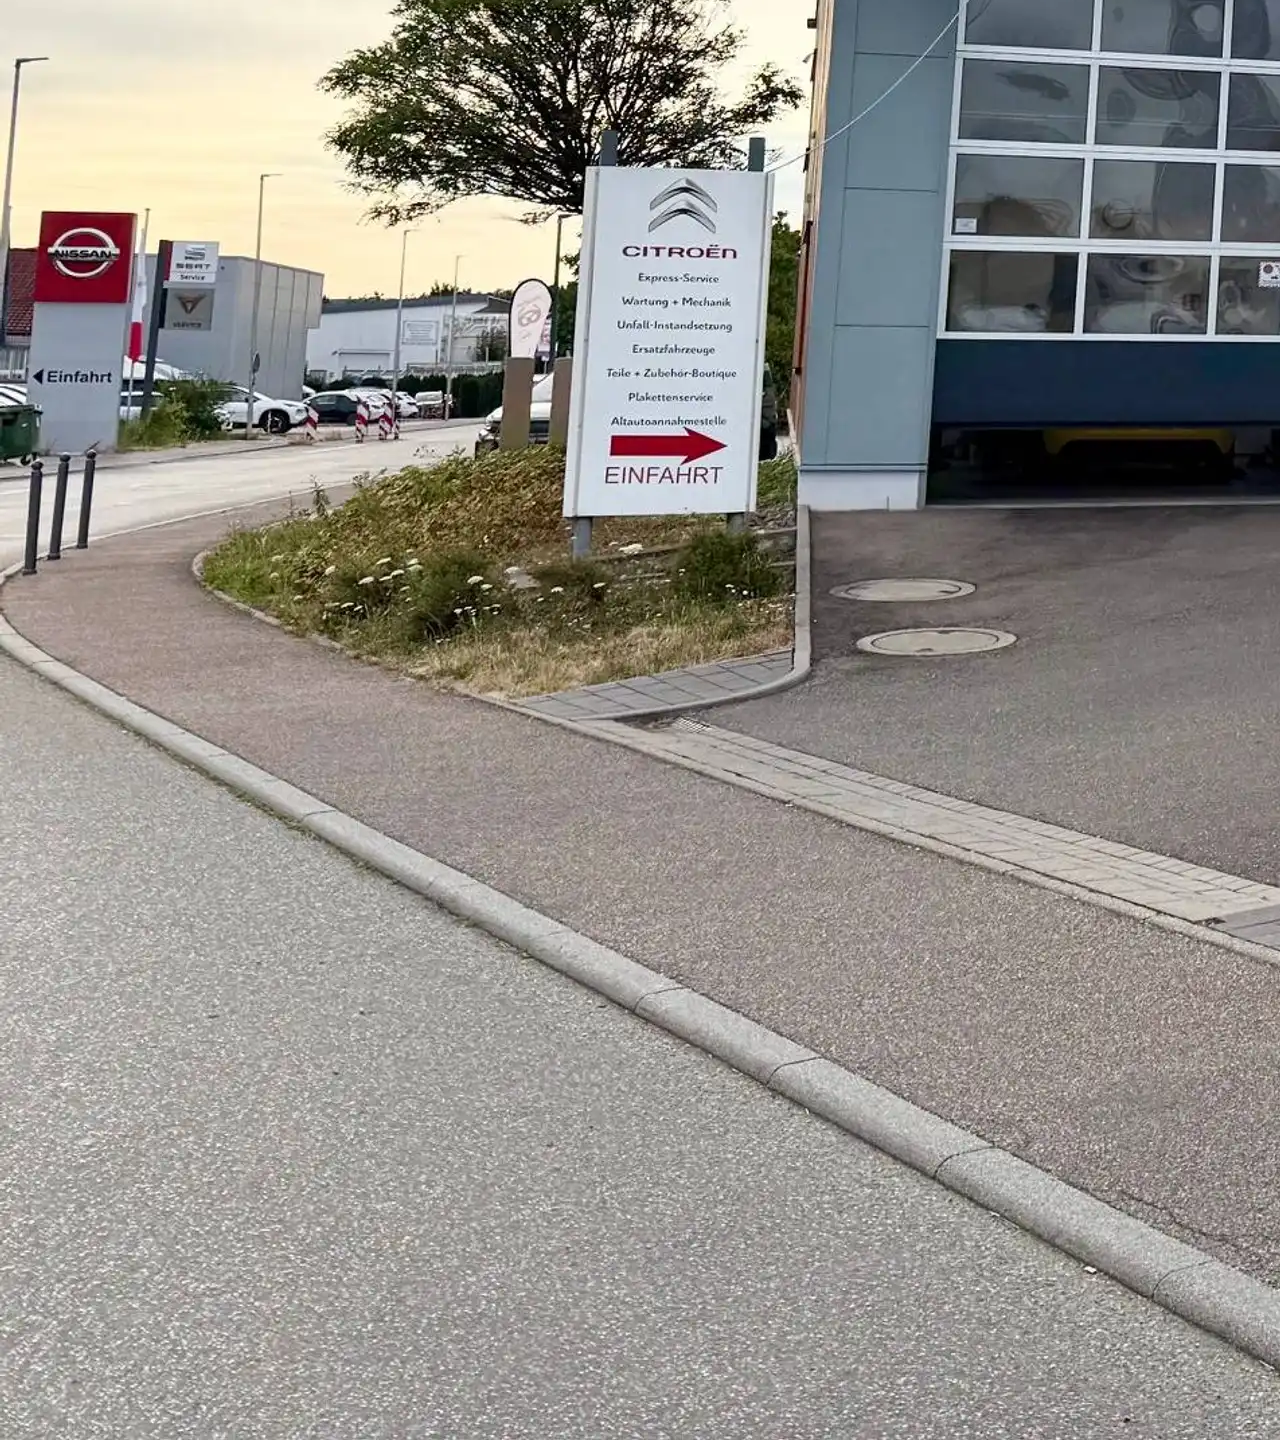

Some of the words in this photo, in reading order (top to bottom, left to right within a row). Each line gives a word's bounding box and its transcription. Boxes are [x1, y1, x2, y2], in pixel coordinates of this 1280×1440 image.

[54, 249, 112, 258] NISSAN
[638, 272, 719, 284] Express-Service
[622, 296, 669, 308] Wartung
[682, 296, 731, 307] Mechanik
[617, 320, 733, 333] Unfall-Instandsetzung
[632, 344, 716, 356] Ersatzfahrzeuge
[47, 371, 112, 383] Einfahrt
[606, 367, 631, 378] Teile
[628, 392, 713, 402] Plakettenservice
[610, 416, 727, 426] Altautoannahmestelle
[605, 466, 724, 484] EINFAHRT
